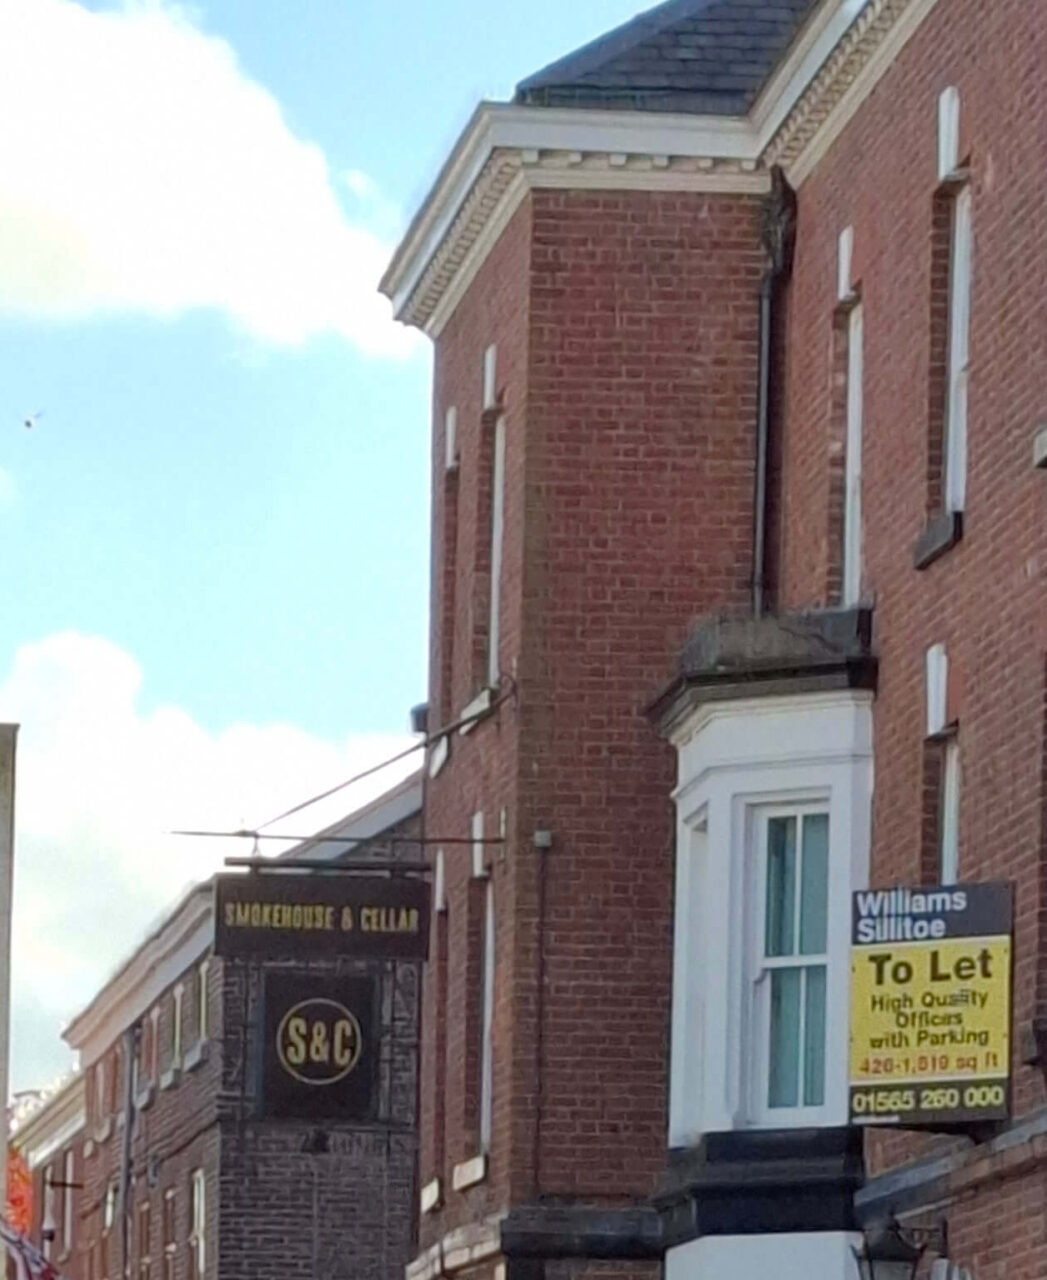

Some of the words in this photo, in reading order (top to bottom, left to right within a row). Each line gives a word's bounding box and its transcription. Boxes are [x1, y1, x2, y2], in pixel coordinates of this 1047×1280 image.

[857, 888, 967, 916] Williams
[225, 902, 334, 930] SMOKEHOUSE
[361, 906, 419, 933] CELLAR
[857, 916, 946, 942] Sillitoe
[868, 953, 913, 985] To
[929, 948, 993, 982] Let
[871, 993, 914, 1012] High
[287, 1017, 351, 1066] S&C
[870, 1031, 909, 1048] with
[917, 1026, 989, 1048] Parking
[964, 1084, 1004, 1107] 000
